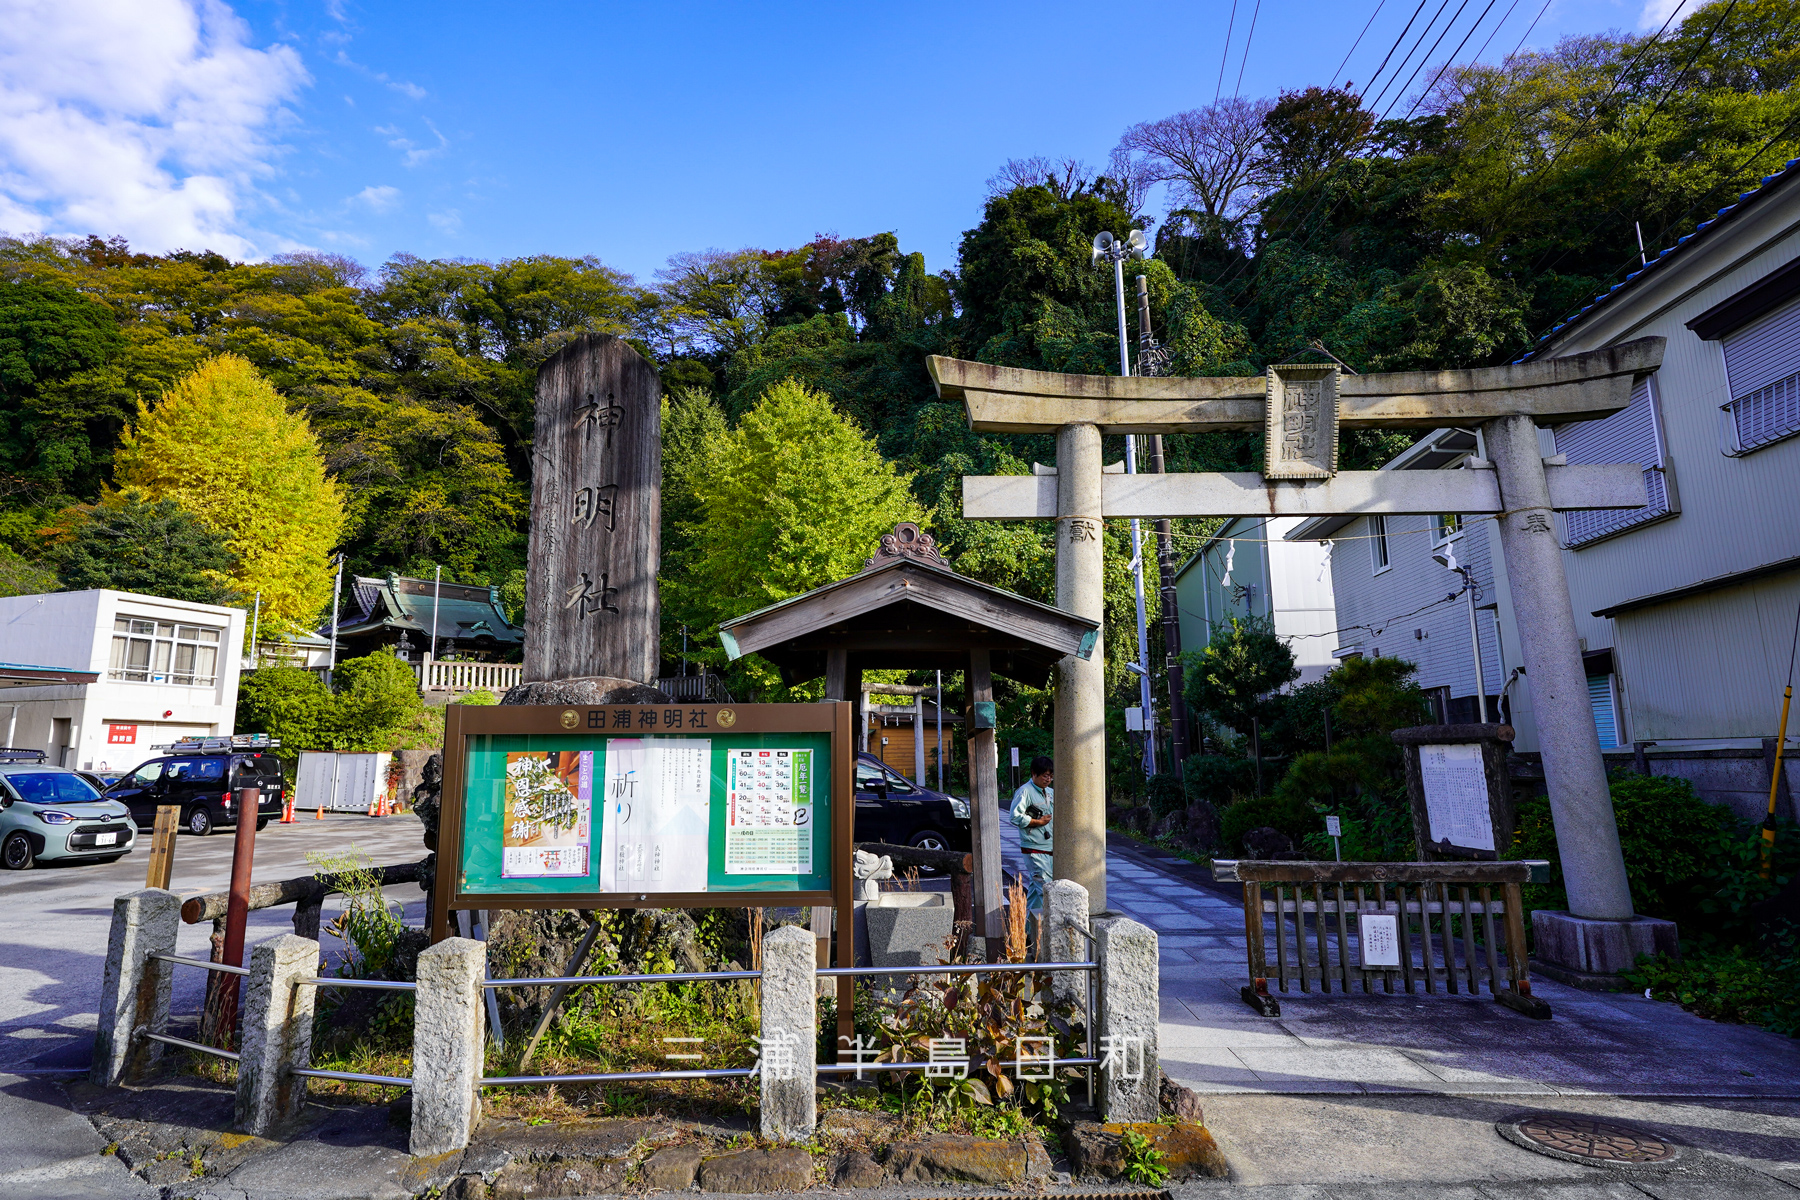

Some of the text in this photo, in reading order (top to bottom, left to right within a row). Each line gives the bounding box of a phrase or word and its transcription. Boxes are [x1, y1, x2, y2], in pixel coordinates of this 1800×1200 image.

[565, 392, 626, 620] 神明社
[587, 709, 708, 728] 田浦神明社
[511, 757, 532, 839] 神恩感謝
[611, 771, 638, 825] 祈り
[799, 763, 807, 794] 厄年一覧
